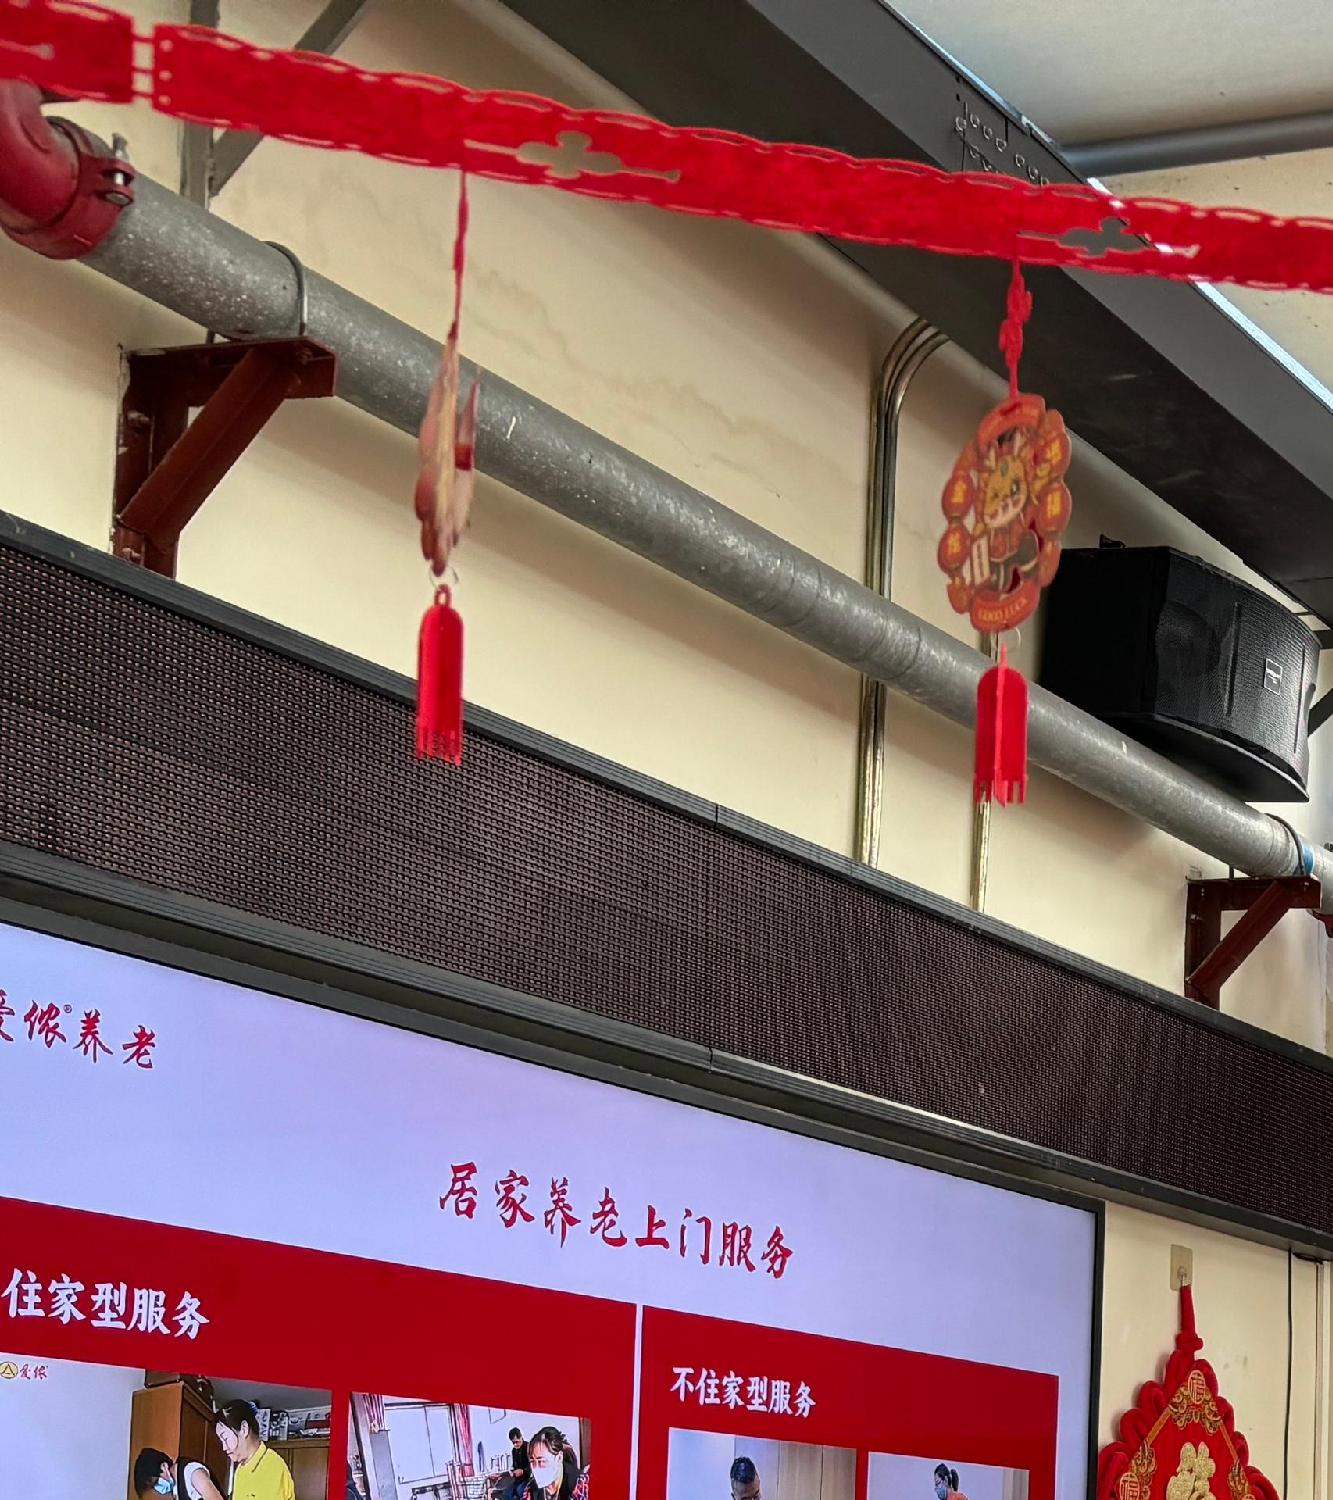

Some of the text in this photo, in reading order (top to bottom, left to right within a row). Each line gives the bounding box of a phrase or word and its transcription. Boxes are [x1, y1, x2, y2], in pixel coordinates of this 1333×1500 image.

[439, 1160, 795, 1280] 居家养老上门服务
[0, 1267, 210, 1340] 住家型服务
[670, 1366, 818, 1418] 不住家型服务
